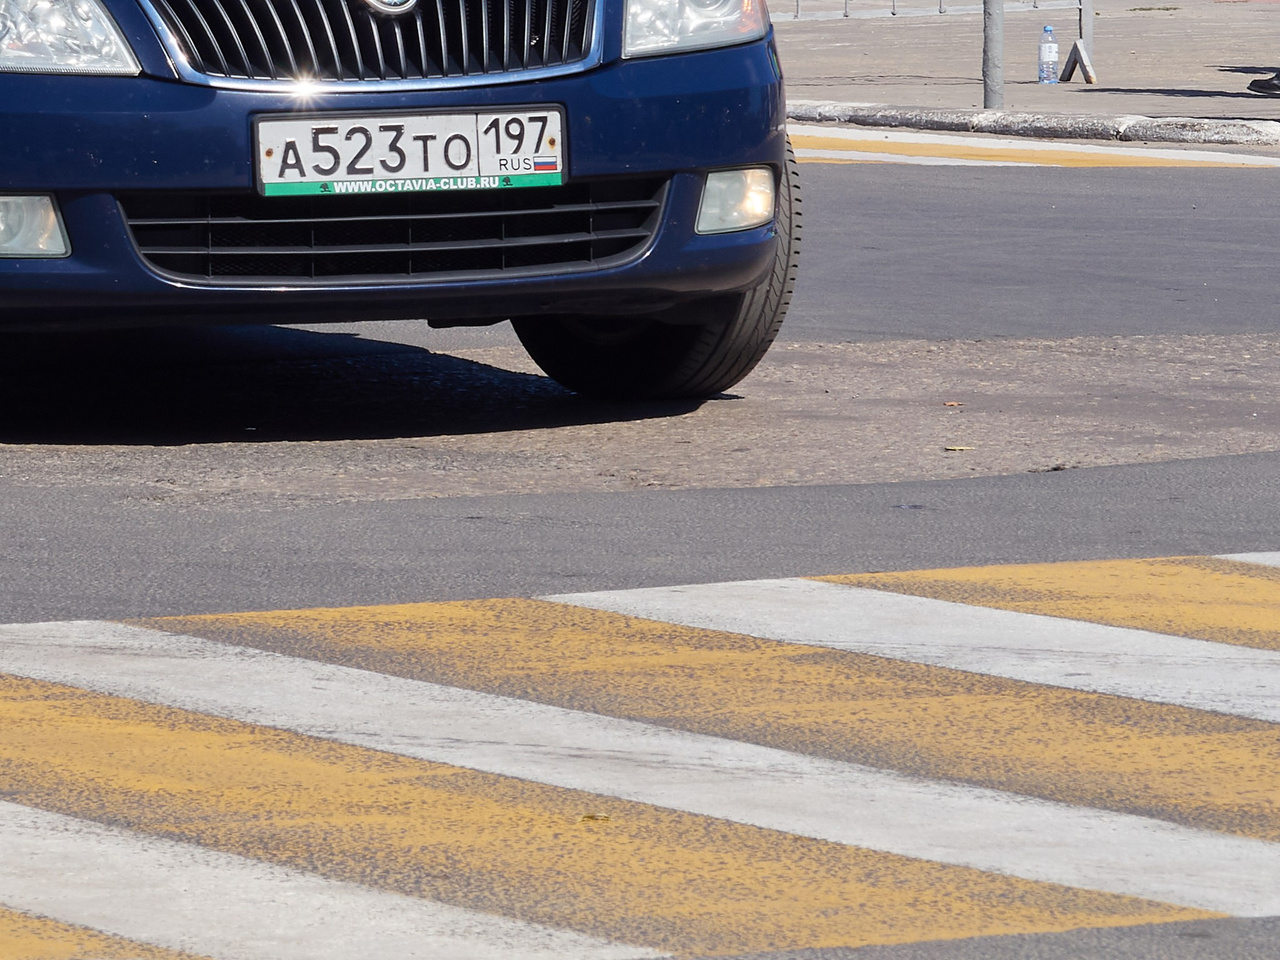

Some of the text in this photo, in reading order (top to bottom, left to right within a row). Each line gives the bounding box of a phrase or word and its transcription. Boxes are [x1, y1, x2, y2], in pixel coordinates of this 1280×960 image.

[483, 116, 548, 155] 197
[499, 157, 532, 171] RUS
[333, 176, 499, 194] WWW.OCTAVIA-CLUB.RU
